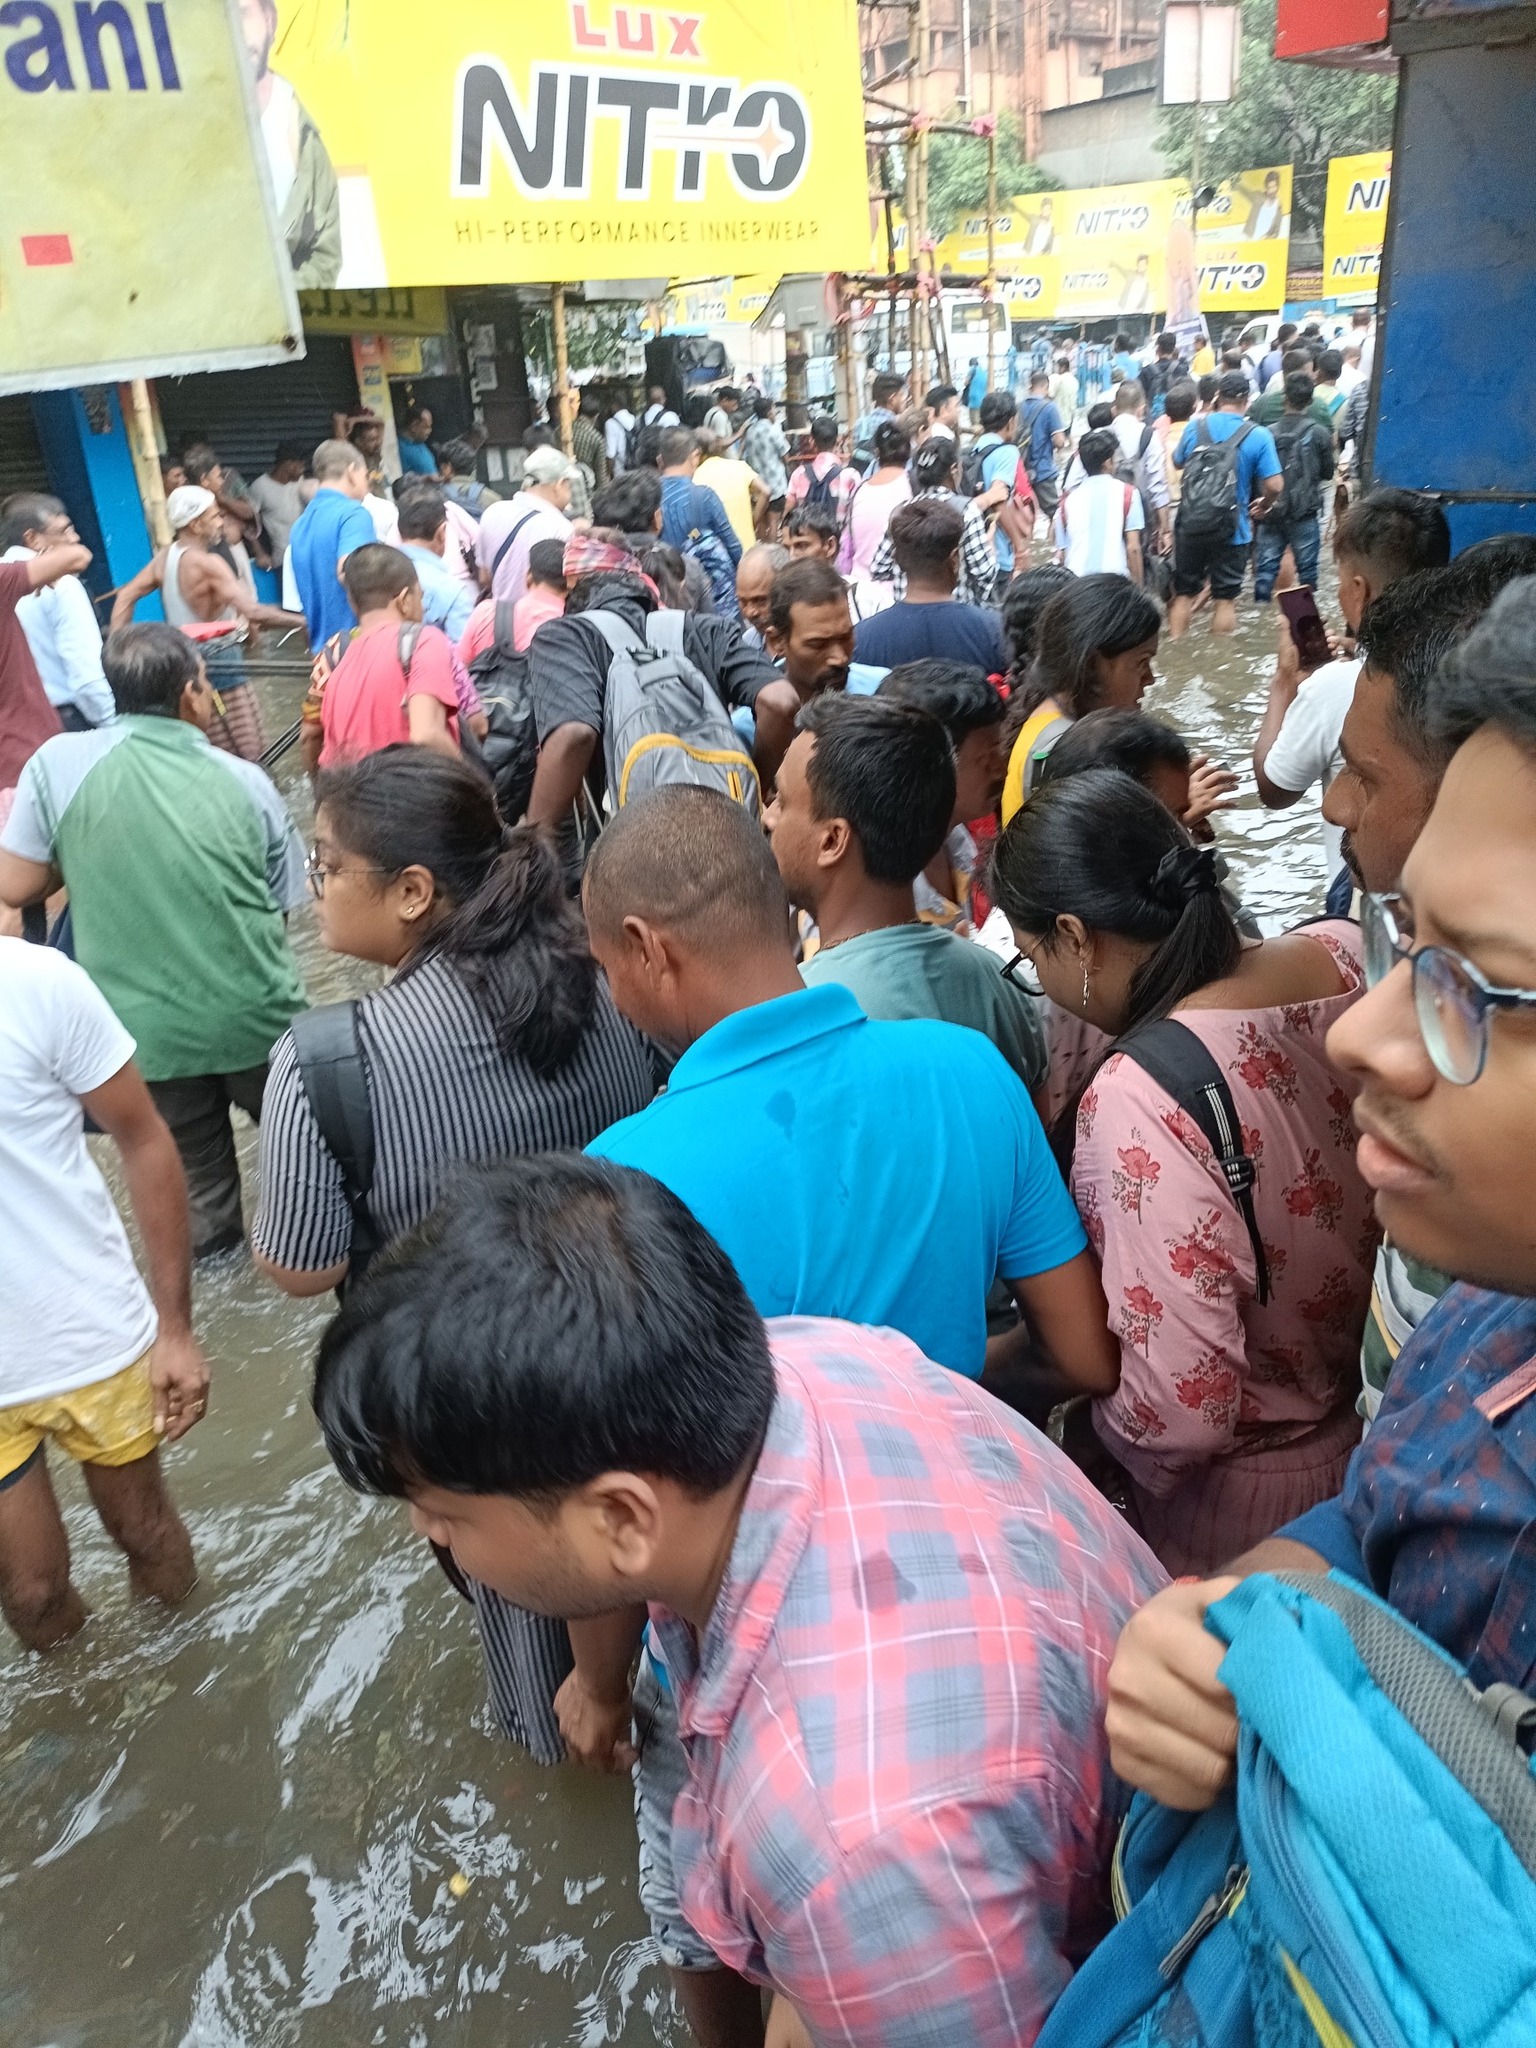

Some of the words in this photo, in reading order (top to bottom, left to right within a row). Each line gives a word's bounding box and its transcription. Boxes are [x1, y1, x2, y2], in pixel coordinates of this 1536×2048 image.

[572, 4, 701, 57] LUX
[459, 64, 807, 191] NITRO
[455, 219, 691, 245] HI-PERFORMANCE
[700, 218, 821, 243] INNERWEAR
